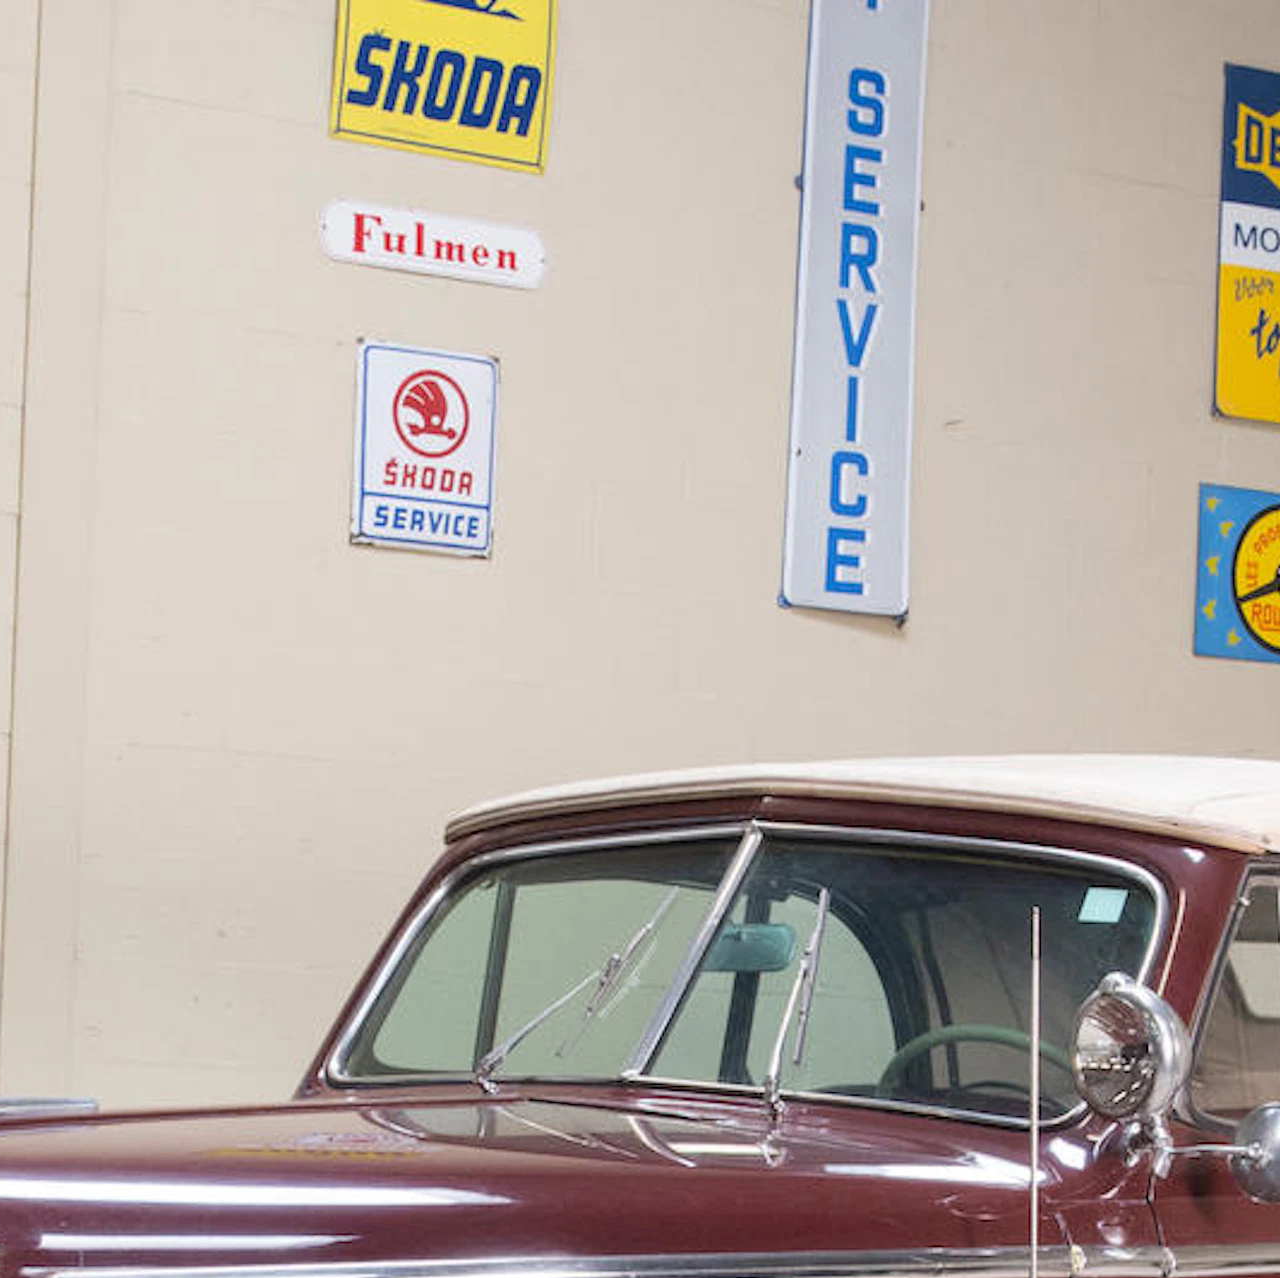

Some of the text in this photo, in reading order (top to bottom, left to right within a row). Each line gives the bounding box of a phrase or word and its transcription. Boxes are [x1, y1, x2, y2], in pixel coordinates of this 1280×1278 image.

[351, 212, 519, 271] Fulmen
[823, 67, 886, 596] SERVICE
[383, 458, 473, 497] ŠKODA
[373, 505, 480, 538] SERVICE
